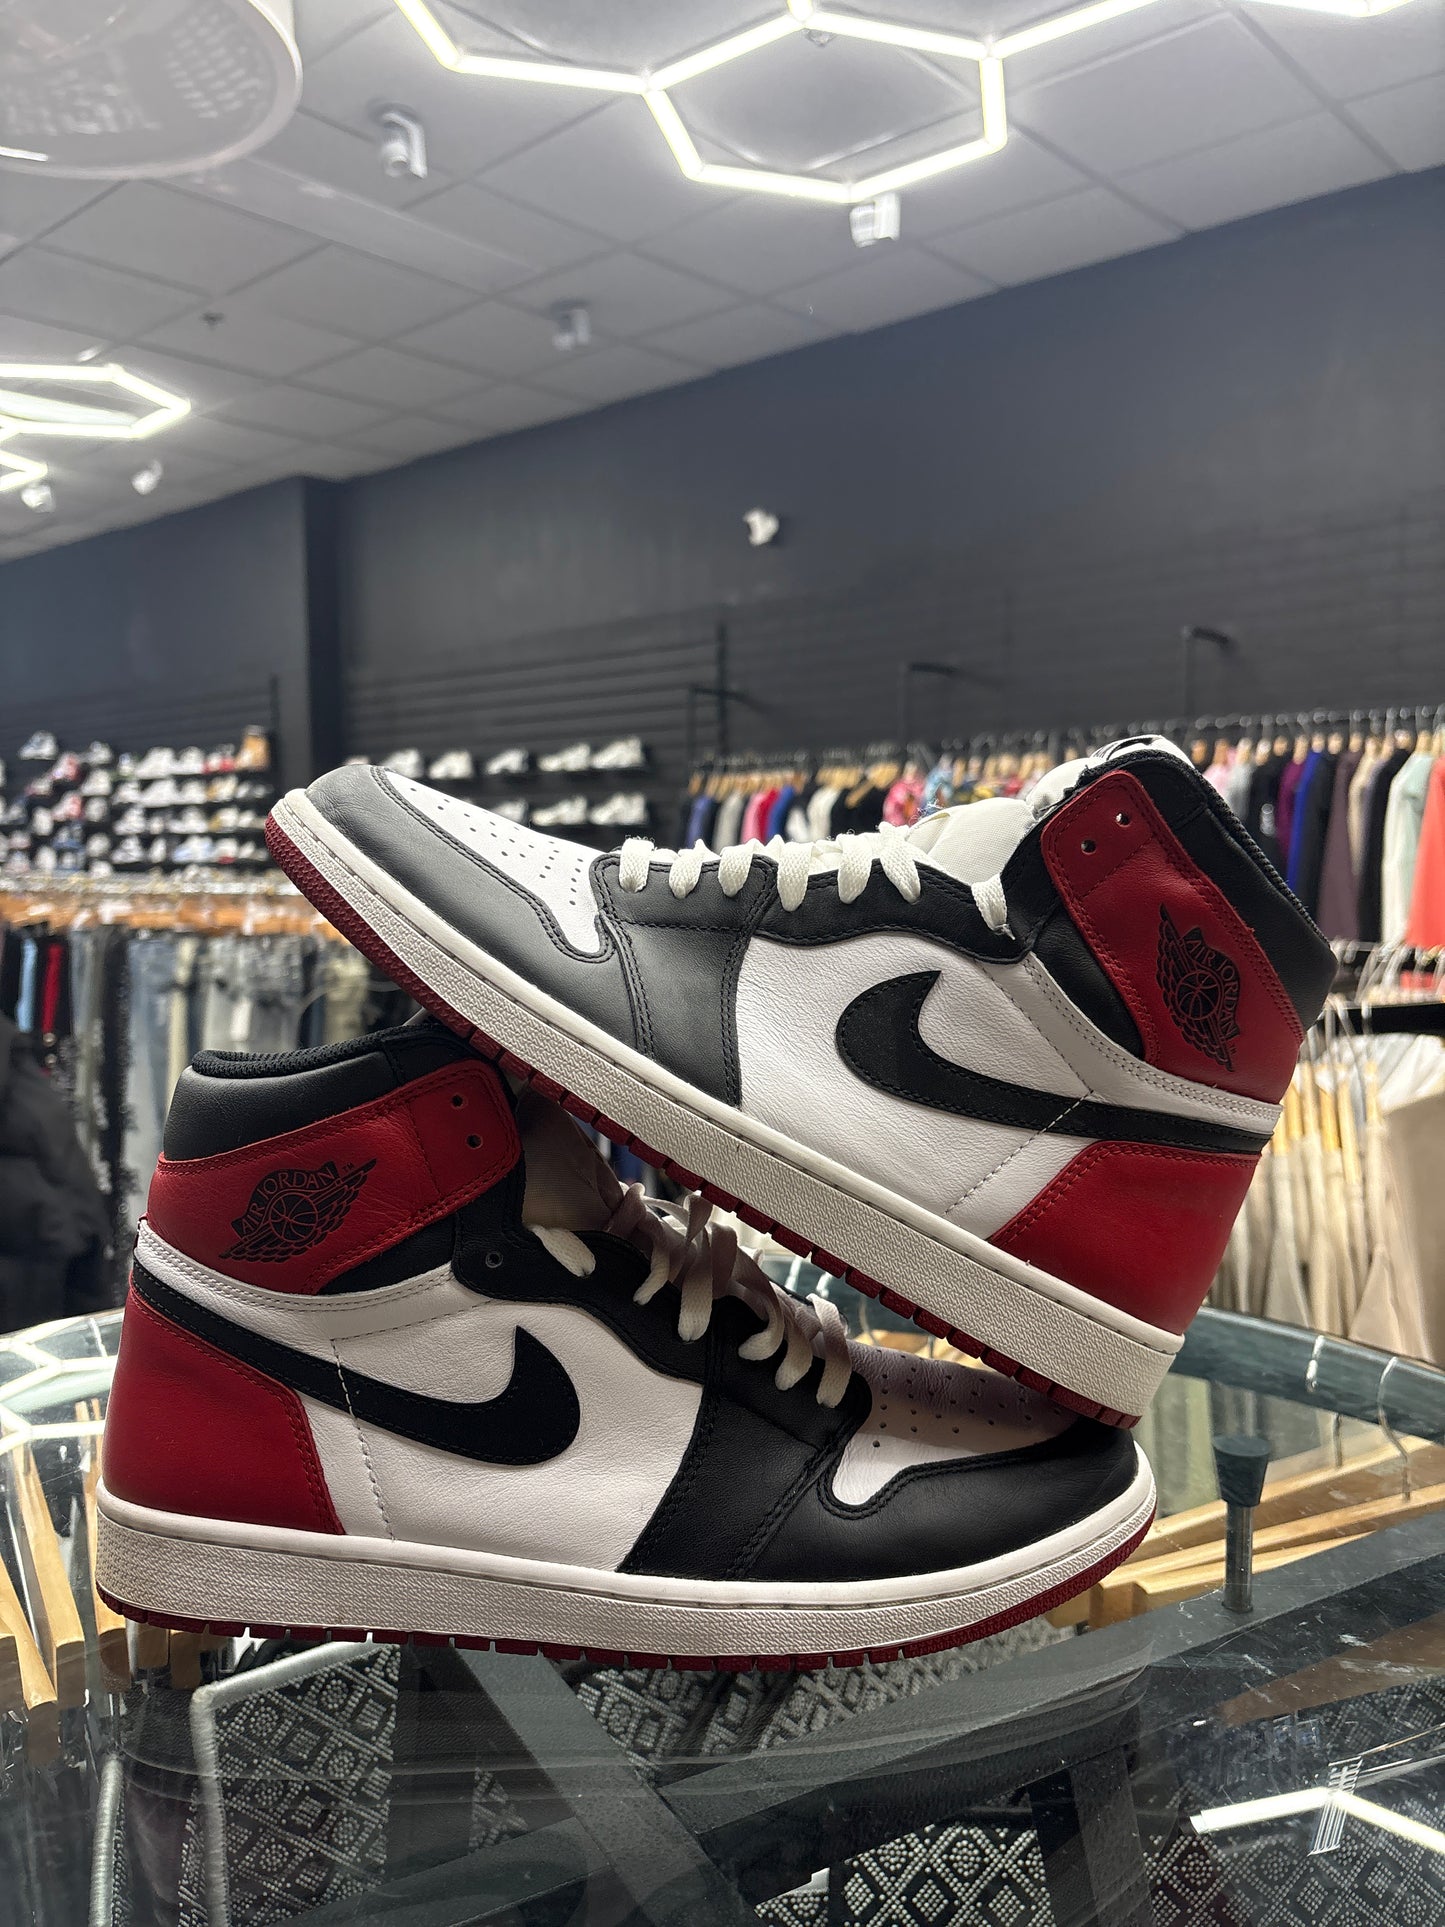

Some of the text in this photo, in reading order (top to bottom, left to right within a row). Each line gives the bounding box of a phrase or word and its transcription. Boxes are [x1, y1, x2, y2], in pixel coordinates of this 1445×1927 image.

[1186, 939, 1239, 1035] AIR JORDAN
[241, 1167, 335, 1234] AIR JORDAN
